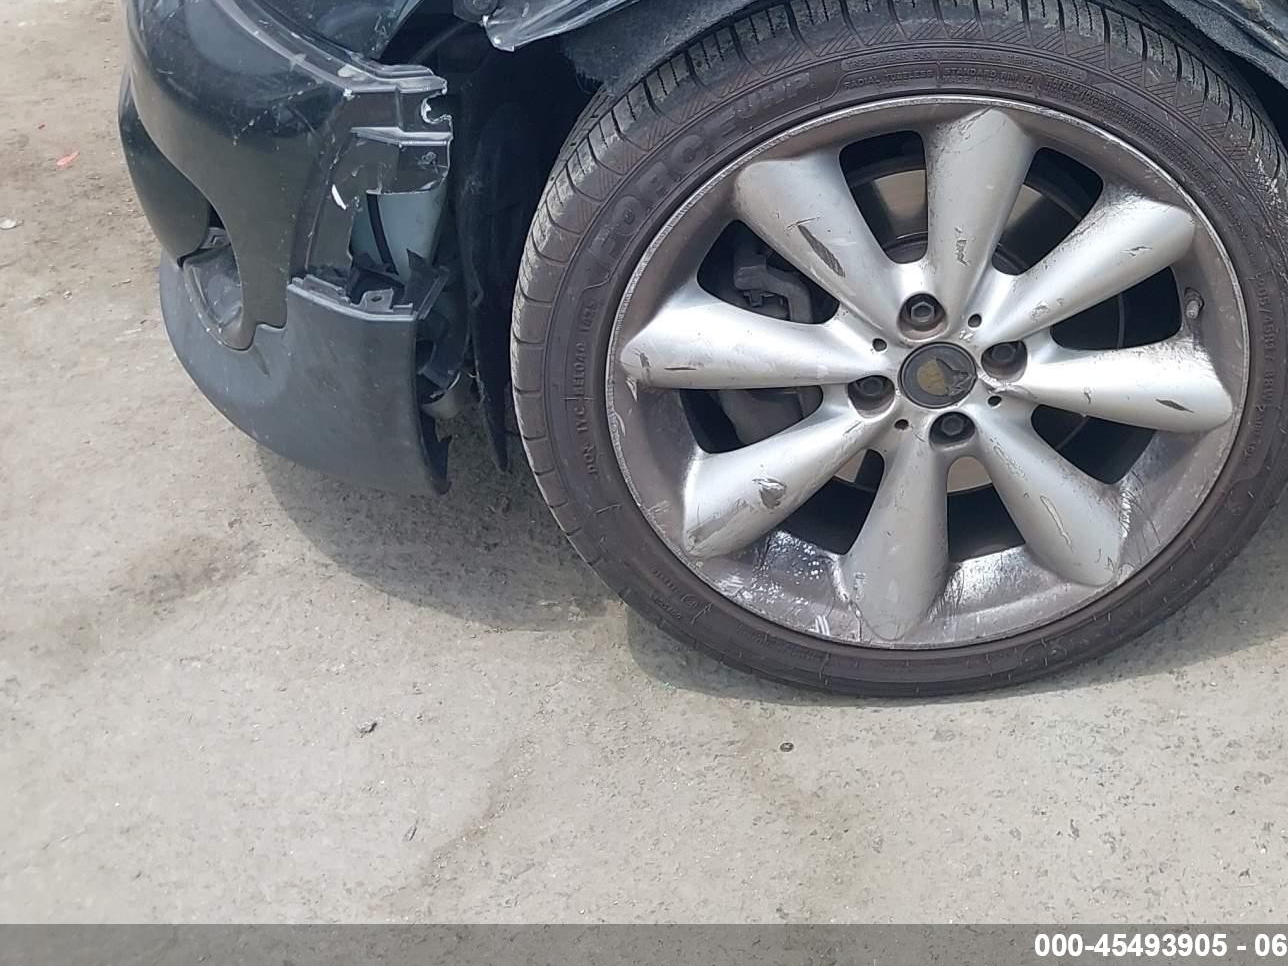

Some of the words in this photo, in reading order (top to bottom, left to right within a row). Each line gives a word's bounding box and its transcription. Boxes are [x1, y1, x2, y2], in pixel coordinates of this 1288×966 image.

[842, 74, 881, 90] RADIAL
[884, 69, 933, 82] TUBELESS
[943, 66, 997, 78] STANDARD
